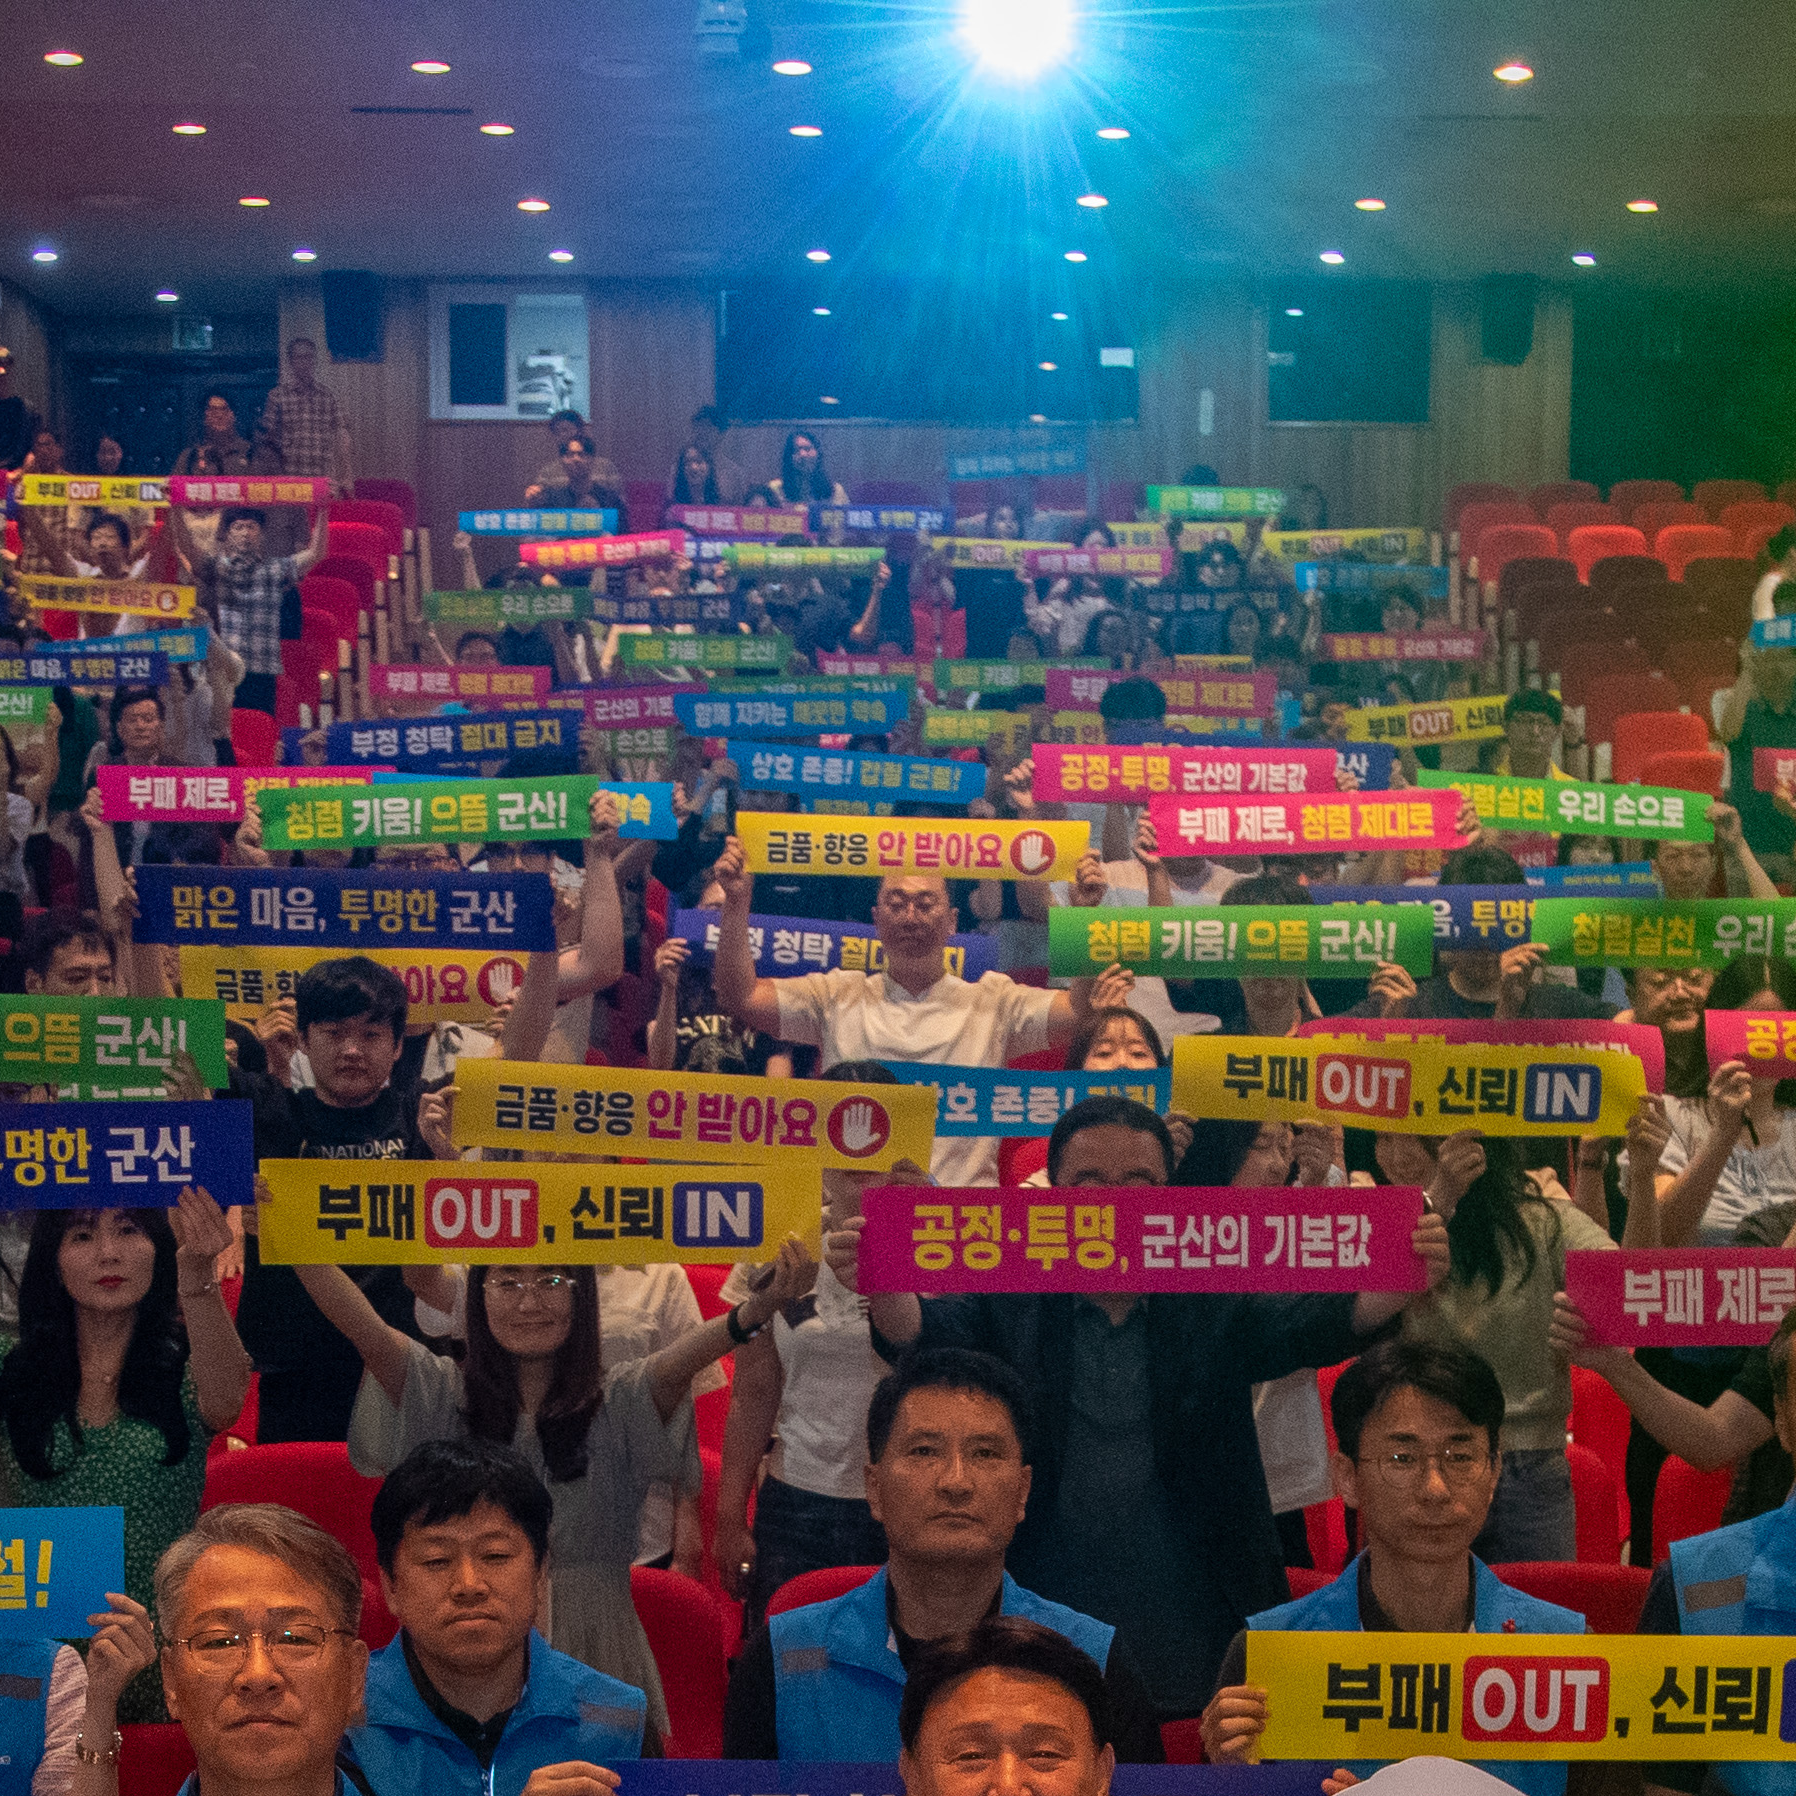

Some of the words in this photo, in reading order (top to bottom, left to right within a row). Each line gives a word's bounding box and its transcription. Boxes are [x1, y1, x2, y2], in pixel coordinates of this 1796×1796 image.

[119, 657, 150, 677] 군산
[351, 730, 399, 757] 부정
[405, 726, 454, 753] 청탁
[460, 723, 508, 751] 절대
[514, 719, 561, 747] 금지
[129, 776, 178, 810] 부패
[751, 752, 795, 781] 상호
[801, 754, 853, 784] 존중!
[859, 759, 903, 788] 갑질
[908, 762, 962, 792] 근절!
[1182, 763, 1242, 793] 군산의
[1248, 763, 1307, 793] 기본값
[286, 802, 343, 839] 청렴
[352, 798, 422, 836] 키움!
[430, 796, 489, 832] 으뜸
[497, 792, 567, 830] 군산!
[1178, 807, 1229, 843] 부패
[1302, 806, 1353, 842] 청렴
[1359, 802, 1434, 839] 제대로
[1558, 790, 1606, 823] 우리
[1612, 794, 1685, 829] 손으로
[877, 831, 906, 867] 안
[913, 832, 1003, 869] 받아요
[172, 886, 240, 928] 맑은
[250, 886, 327, 932] 마음,
[339, 888, 440, 933] 투명한
[449, 890, 518, 934] 군산
[1087, 920, 1151, 962] 청렴
[1160, 920, 1239, 962] 키움!
[1246, 920, 1310, 962] 으뜸
[1319, 921, 1397, 964] 군산!
[1712, 914, 1775, 956] 우리
[4, 1012, 81, 1064] 으뜸
[1223, 1053, 1308, 1101] 부패
[1438, 1066, 1518, 1116] 신뢰
[1533, 1071, 1594, 1117] IN
[495, 1084, 635, 1137] 금품·향응
[647, 1090, 687, 1141] 안
[697, 1091, 819, 1148] 받아요
[106, 1124, 196, 1185] 군산
[317, 1183, 415, 1241] 부패
[569, 1185, 664, 1241] 신뢰
[685, 1190, 752, 1239] IN
[912, 1203, 1130, 1274] 공정·투명,
[1140, 1215, 1251, 1269] 군산의
[1264, 1215, 1373, 1269] 기본값
[1622, 1266, 1705, 1327] 부패
[1321, 1661, 1451, 1735] 부패
[1650, 1666, 1773, 1736] 신뢰
